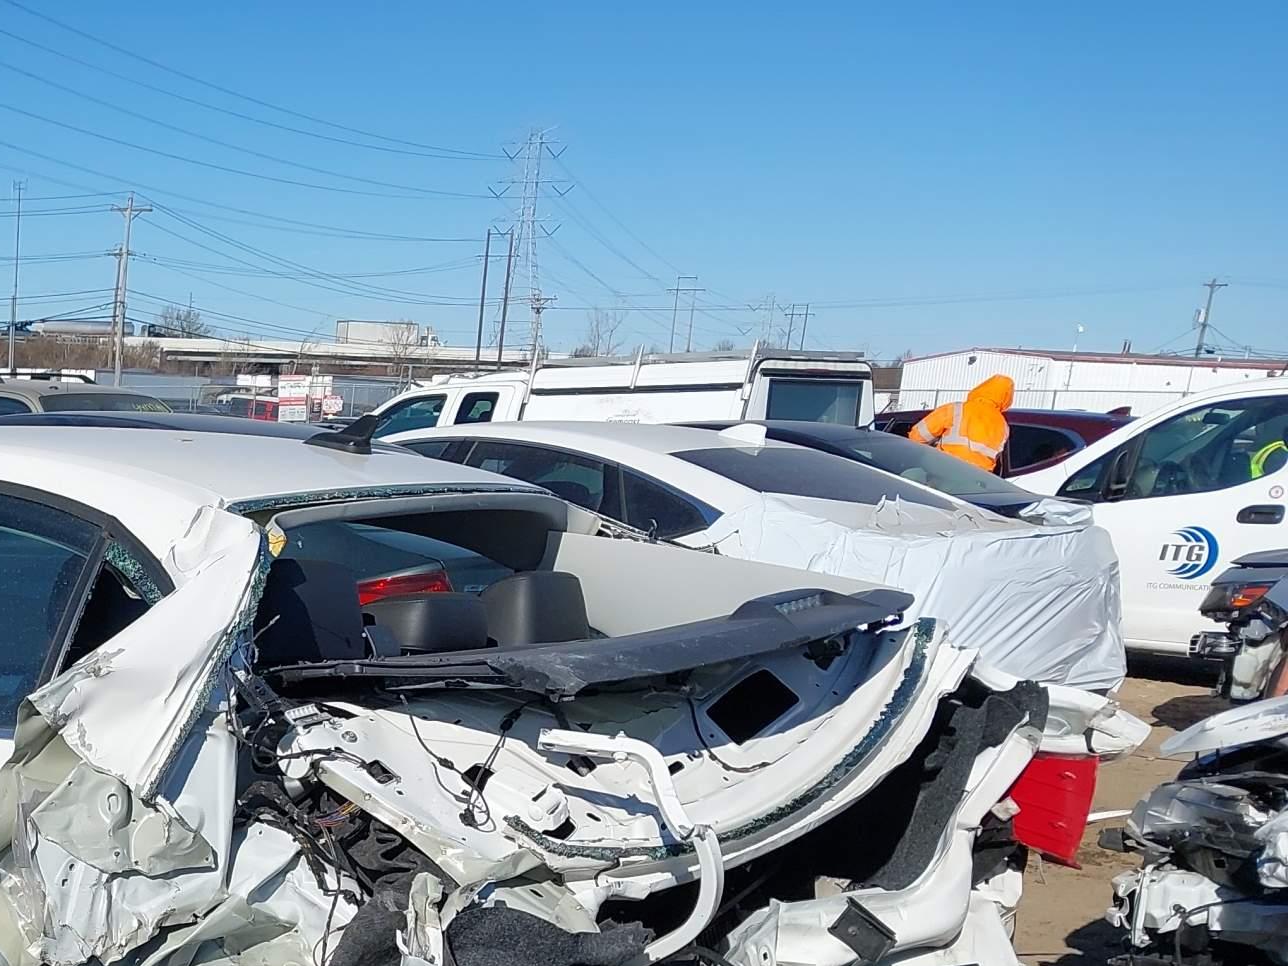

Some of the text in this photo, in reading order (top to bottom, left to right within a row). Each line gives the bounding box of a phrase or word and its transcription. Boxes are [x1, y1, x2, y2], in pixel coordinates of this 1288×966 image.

[1159, 543, 1205, 562] ITG
[1146, 582, 1210, 591] ITG COMMUNICATI
